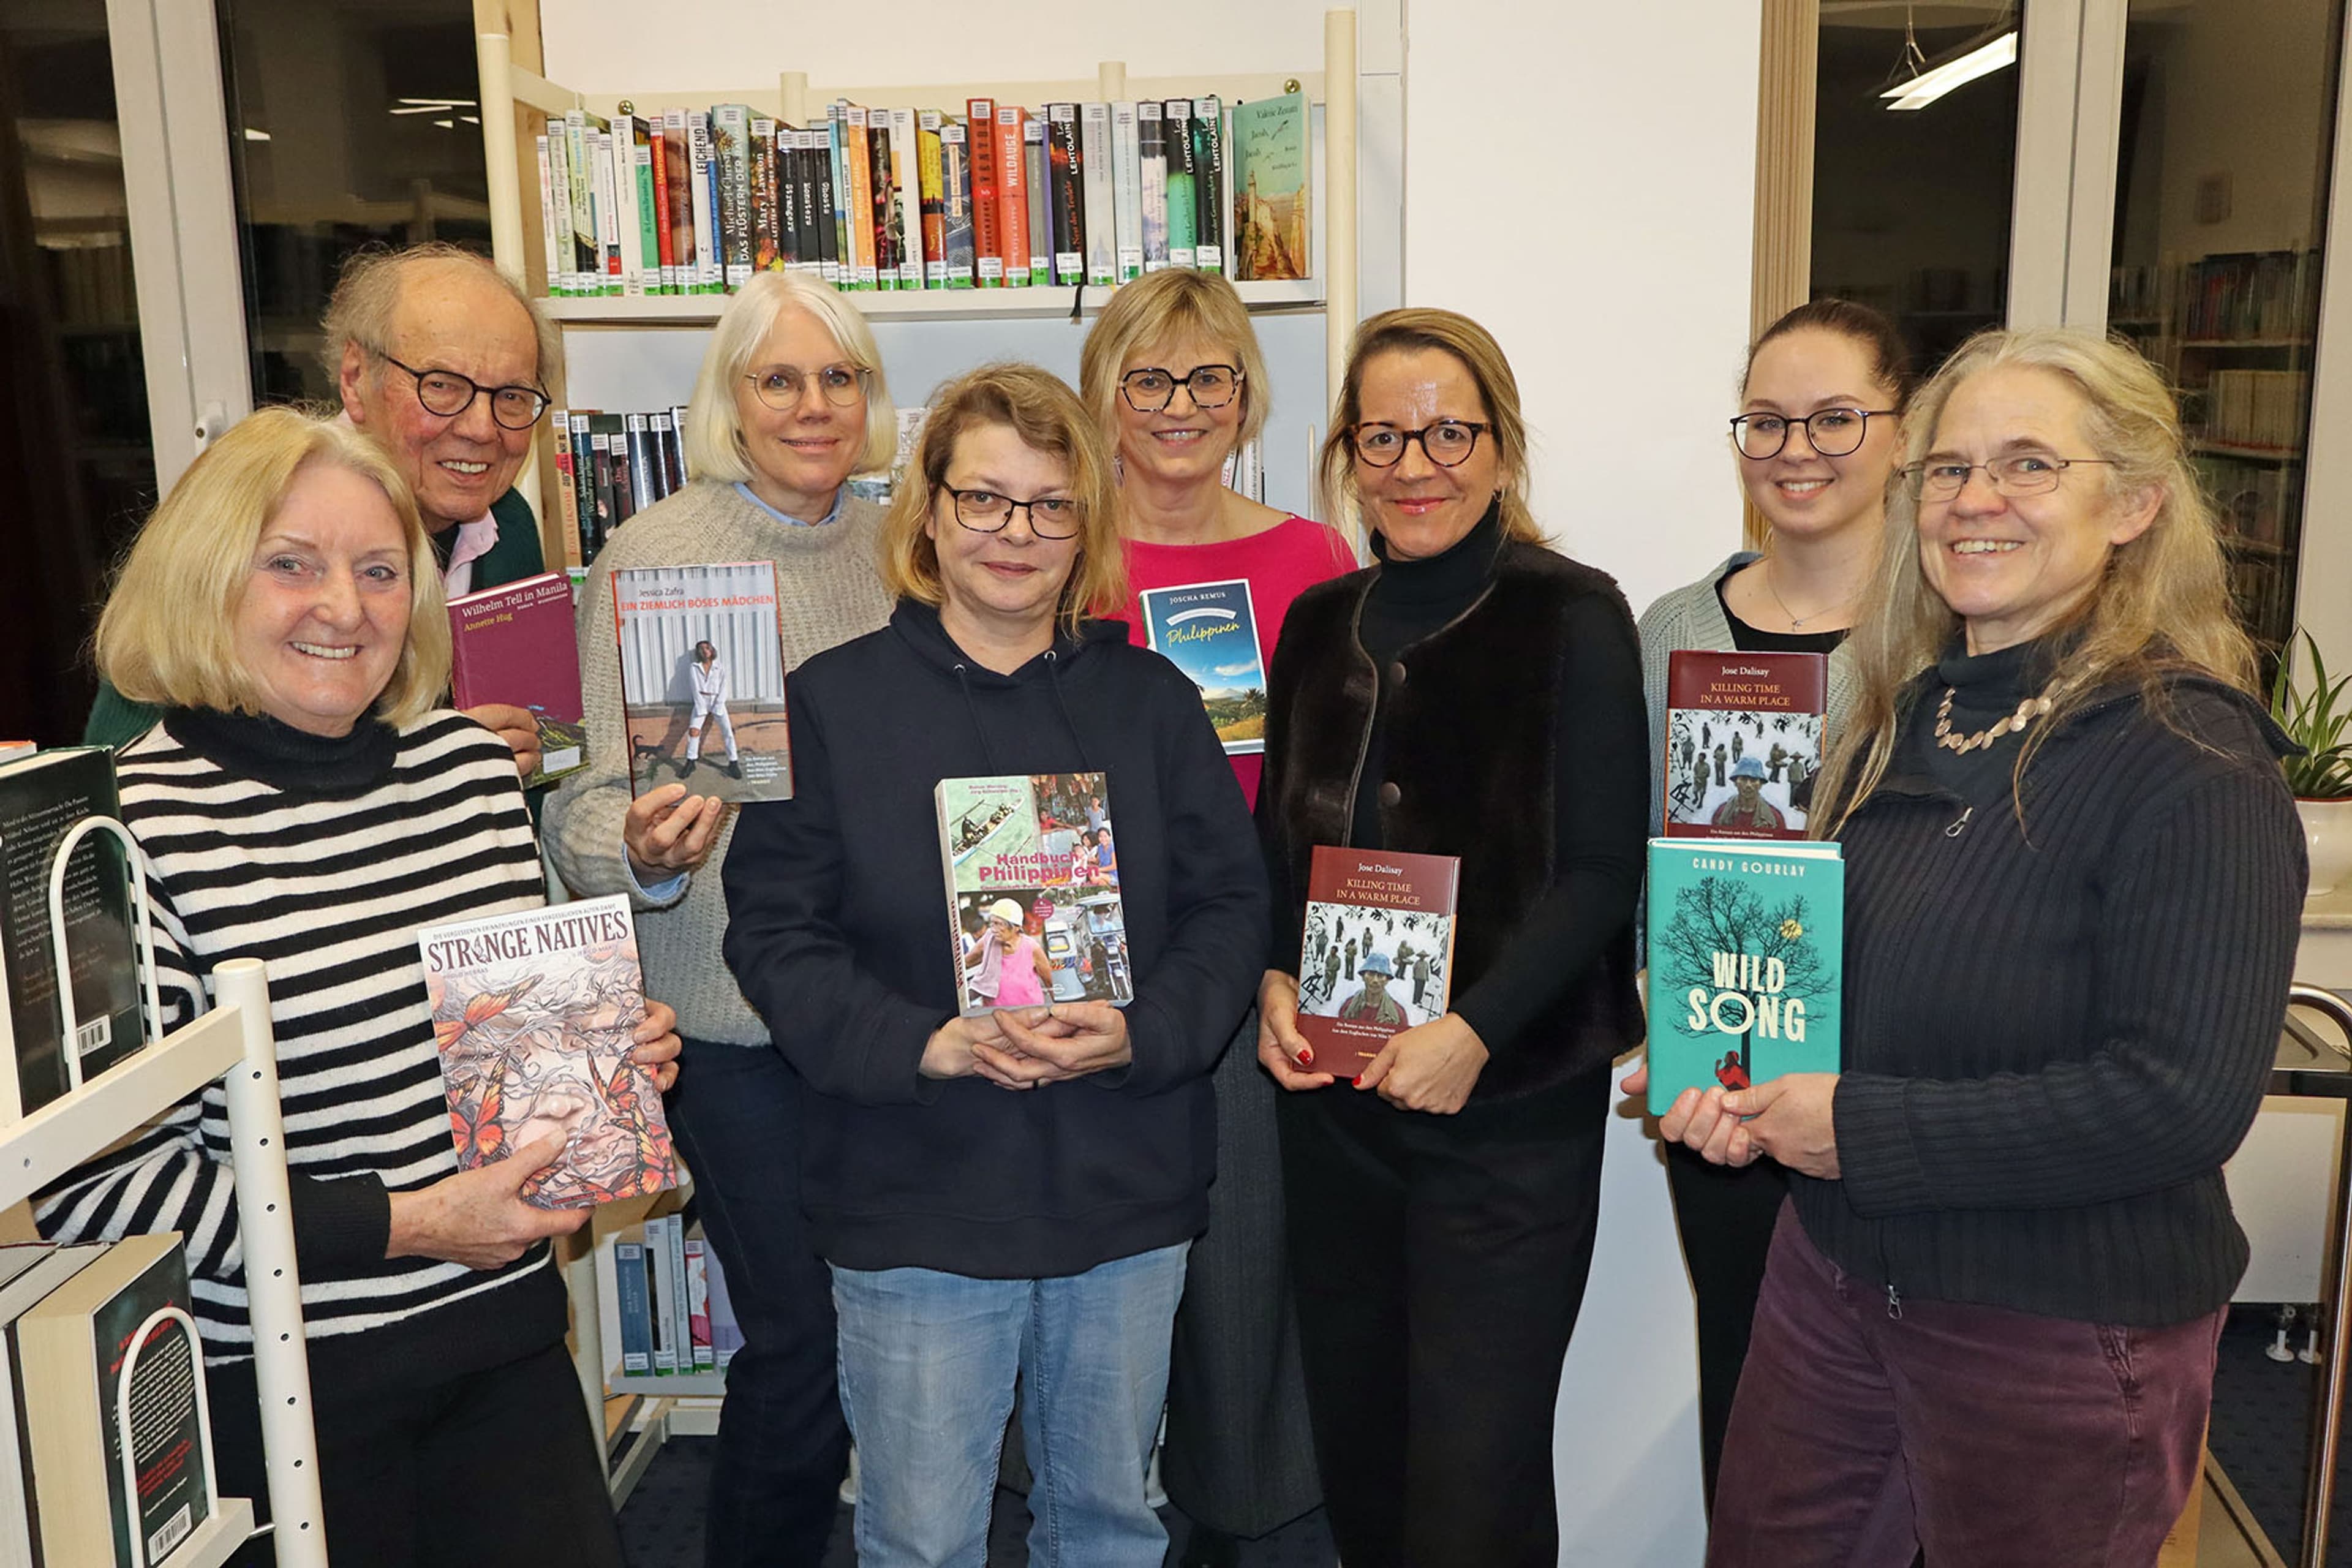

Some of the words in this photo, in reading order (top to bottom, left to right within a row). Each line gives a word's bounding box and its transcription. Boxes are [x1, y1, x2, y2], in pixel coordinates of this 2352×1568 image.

[694, 128, 707, 175] LEICHEND
[1065, 121, 1079, 175] LEHTOLAIN
[1182, 118, 1193, 173] LEHTOLAIN
[1209, 117, 1221, 172] LEHTOLAIN
[734, 160, 744, 181] DER
[1005, 134, 1018, 187] WILDAUGE
[755, 153, 766, 196] Lawson
[723, 192, 735, 236] Michael
[736, 184, 747, 237] FLÜSTERN
[758, 201, 768, 229] Mary
[739, 240, 750, 261] DAS
[462, 600, 504, 618] Wilhelm
[504, 594, 522, 606] Tell
[524, 591, 534, 601] in
[535, 582, 568, 598] Manila
[621, 601, 638, 611] EIN
[640, 600, 685, 611] ZIEMLICH
[688, 597, 719, 608] BÖSES
[722, 594, 774, 606] MÄDCHEN
[639, 588, 663, 598] Jessica
[665, 586, 684, 596] Zafra
[1169, 595, 1199, 605] JOSCHA
[1199, 592, 1226, 600] REMUS
[464, 617, 495, 632] Annette
[496, 612, 513, 622] Hug
[1166, 623, 1240, 647] Philippinen
[1722, 666, 1738, 676] Jose
[1740, 666, 1770, 678] Dalisay
[1711, 682, 1752, 693] KILLING
[1754, 684, 1781, 694] TIME
[1700, 694, 1713, 704] IN
[1724, 695, 1756, 705] WARM
[1758, 696, 1790, 706] PLACE
[996, 851, 1079, 865] Handbuch
[1693, 857, 1733, 872] CANDY
[1742, 861, 1806, 878] GOURLAY
[979, 864, 1100, 883] Philippinen
[1358, 862, 1374, 872] Jose
[1374, 864, 1403, 877] Dalisay
[1347, 878, 1385, 891] KILLING
[1387, 881, 1412, 893] TIME
[1336, 889, 1348, 899] IN
[1349, 891, 1356, 899] A
[1358, 891, 1389, 903] WARM
[1390, 895, 1421, 905] PLACE
[534, 910, 628, 954] NATIVES
[1713, 951, 1785, 994] WILD
[1687, 987, 1806, 1042] SONG
